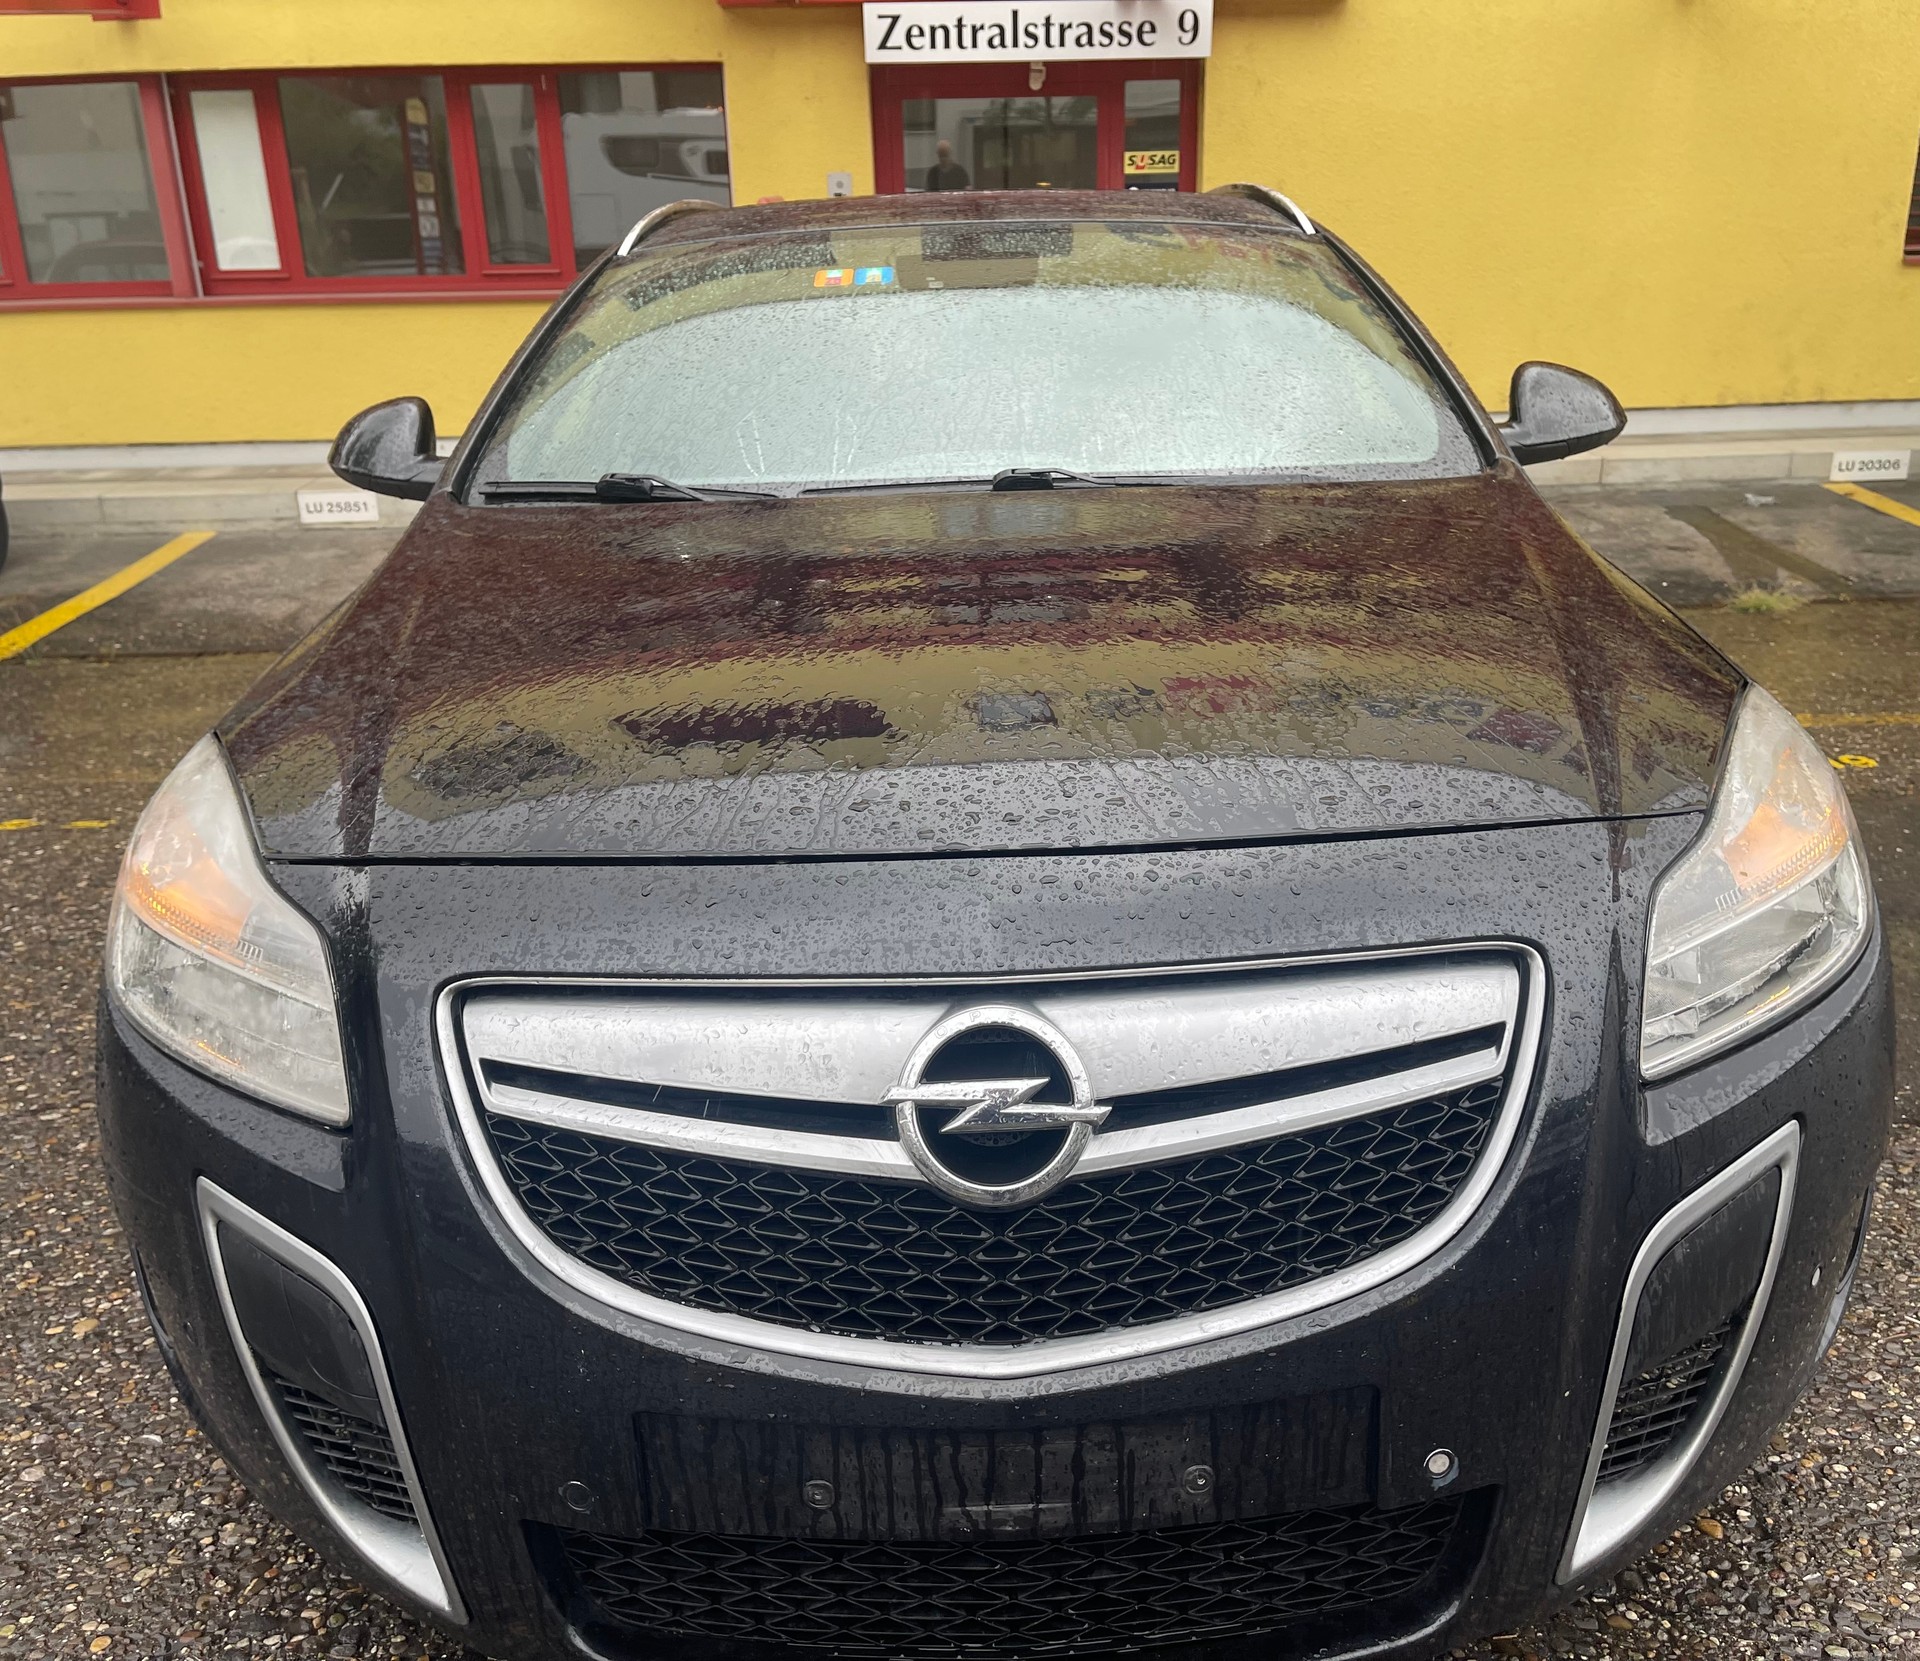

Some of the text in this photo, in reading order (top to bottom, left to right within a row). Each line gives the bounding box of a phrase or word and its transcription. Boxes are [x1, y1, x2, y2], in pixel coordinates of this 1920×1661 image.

[876, 9, 1200, 50] Zentralstrasse 9
[1838, 461, 1856, 472] LU
[305, 502, 323, 514] LU
